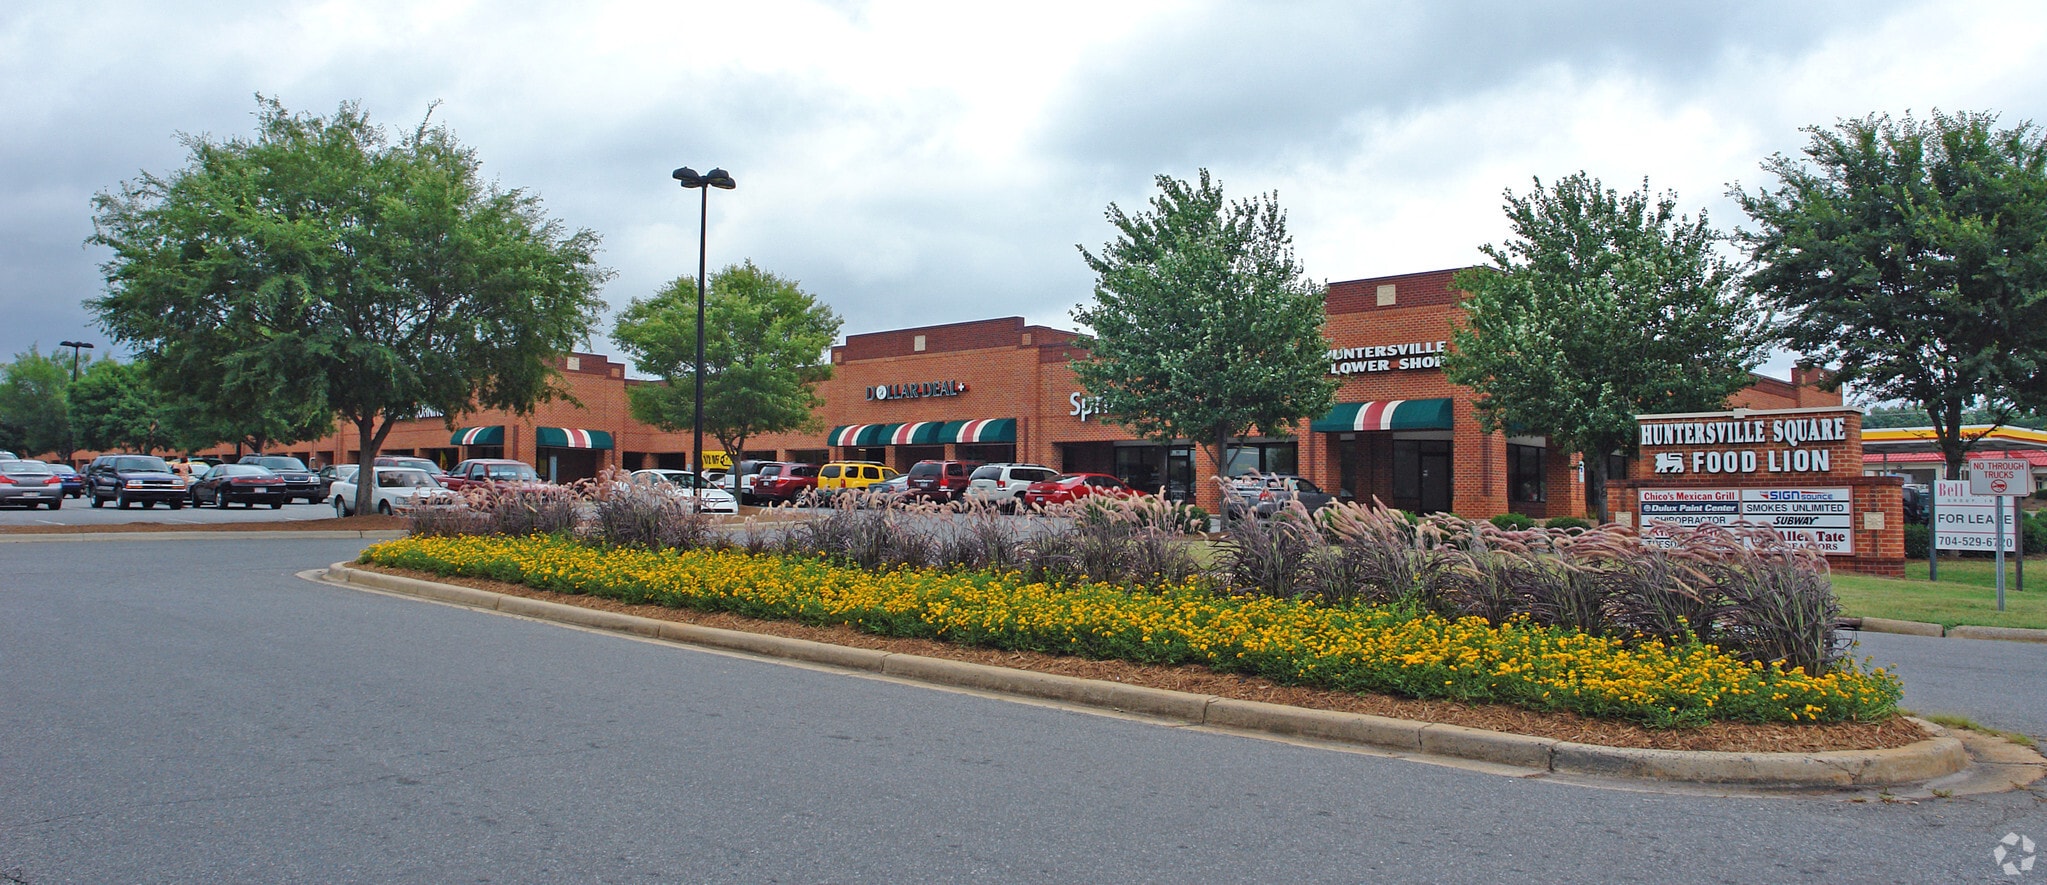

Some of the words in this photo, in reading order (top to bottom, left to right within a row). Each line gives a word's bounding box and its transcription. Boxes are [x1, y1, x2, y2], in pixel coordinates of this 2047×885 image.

[1330, 360, 1390, 374] LOWER
[866, 384, 918, 401] DOLLAR
[1641, 420, 1766, 445] HUNTERSVILLE
[1773, 417, 1846, 447] SQUARE
[1692, 451, 1757, 473] FOOD
[1768, 449, 1831, 472] LION
[1973, 462, 1985, 470] NO
[1988, 462, 2024, 470] THROUGH
[1984, 471, 2014, 479] TRUCKS
[1939, 483, 1963, 496] Bell
[1644, 492, 1674, 500] Chico's
[1676, 492, 1712, 500] Mexican
[1715, 492, 1735, 500] Grill
[1746, 504, 1788, 512] SMOKES
[1792, 504, 1844, 512] UNLIMITED
[1773, 516, 1819, 525] SUBWAY
[1938, 514, 1964, 523] FOR
[1968, 514, 2013, 524] LEAE
[1816, 531, 1845, 542] Tate
